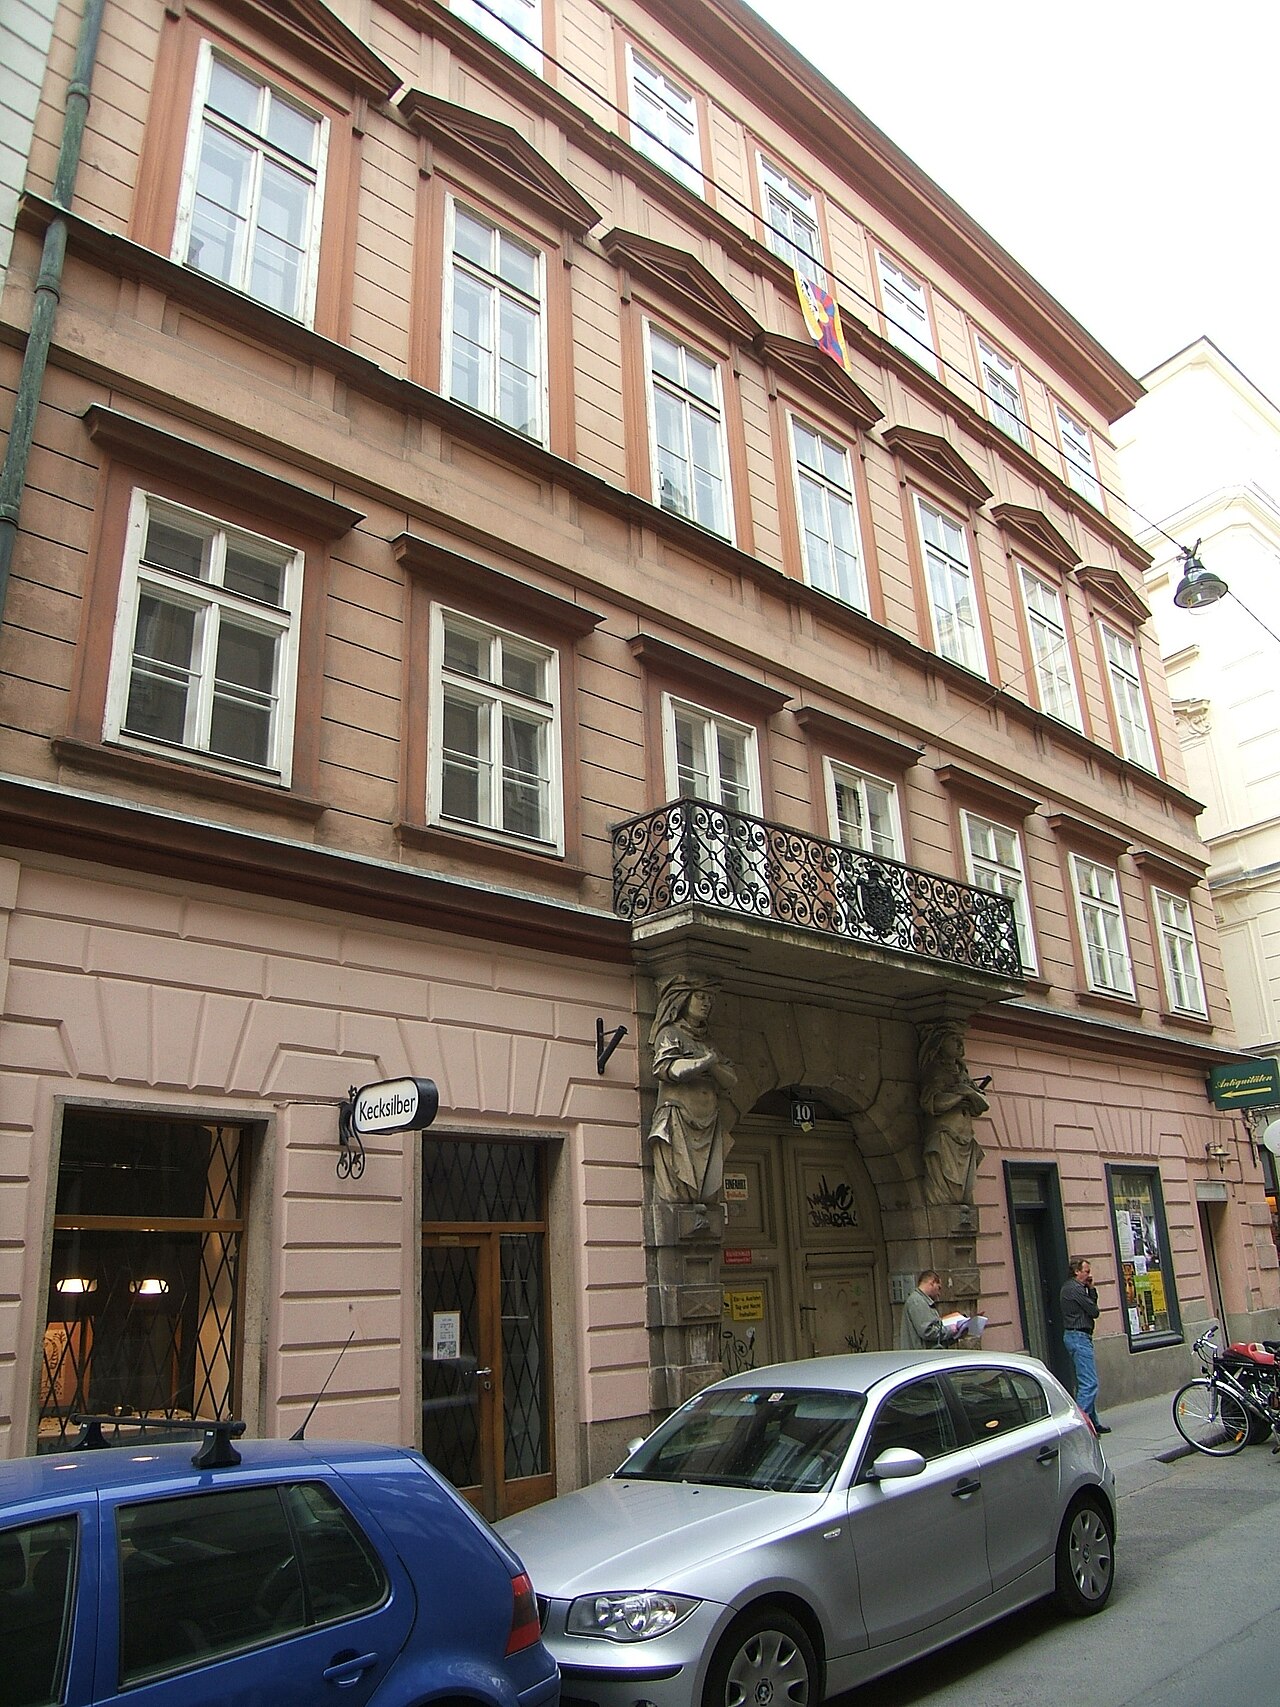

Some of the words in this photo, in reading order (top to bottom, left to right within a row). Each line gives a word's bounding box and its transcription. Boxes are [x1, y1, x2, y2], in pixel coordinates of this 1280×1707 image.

[1215, 1074, 1273, 1089] Antiquitäten
[359, 1094, 416, 1122] Kecksilber
[795, 1104, 811, 1120] 10
